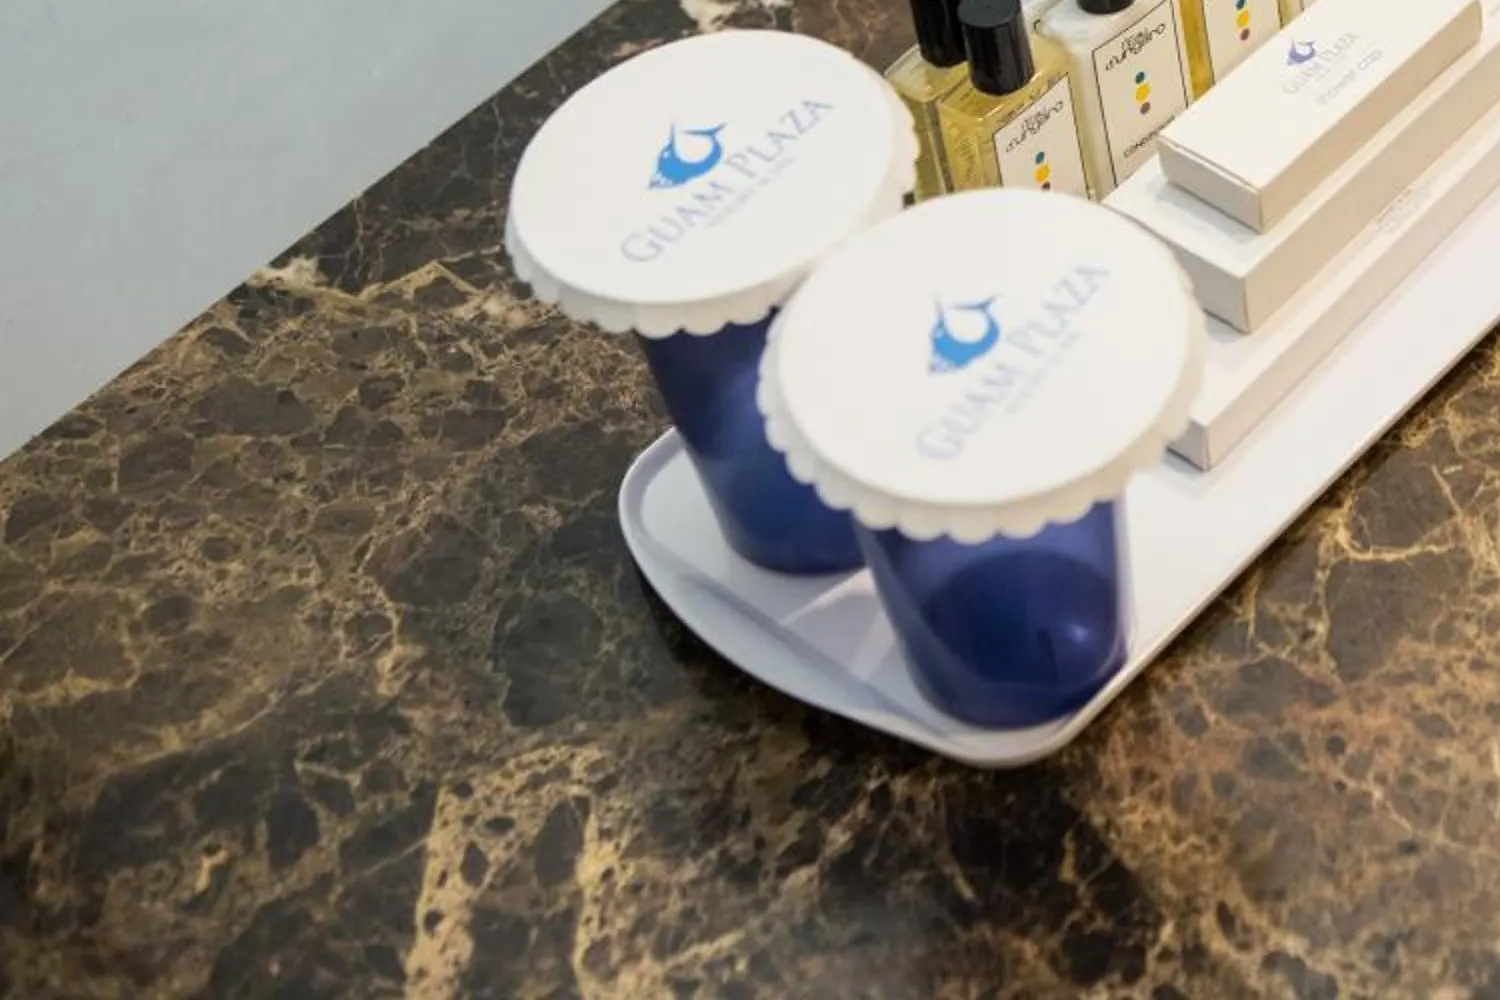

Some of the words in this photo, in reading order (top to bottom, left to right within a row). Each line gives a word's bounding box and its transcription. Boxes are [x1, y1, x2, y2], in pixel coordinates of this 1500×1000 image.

[620, 180, 735, 263] GUAM
[725, 99, 834, 179] PLAZA
[915, 363, 1025, 460] GUAM
[1005, 266, 1111, 358] PLAZA
